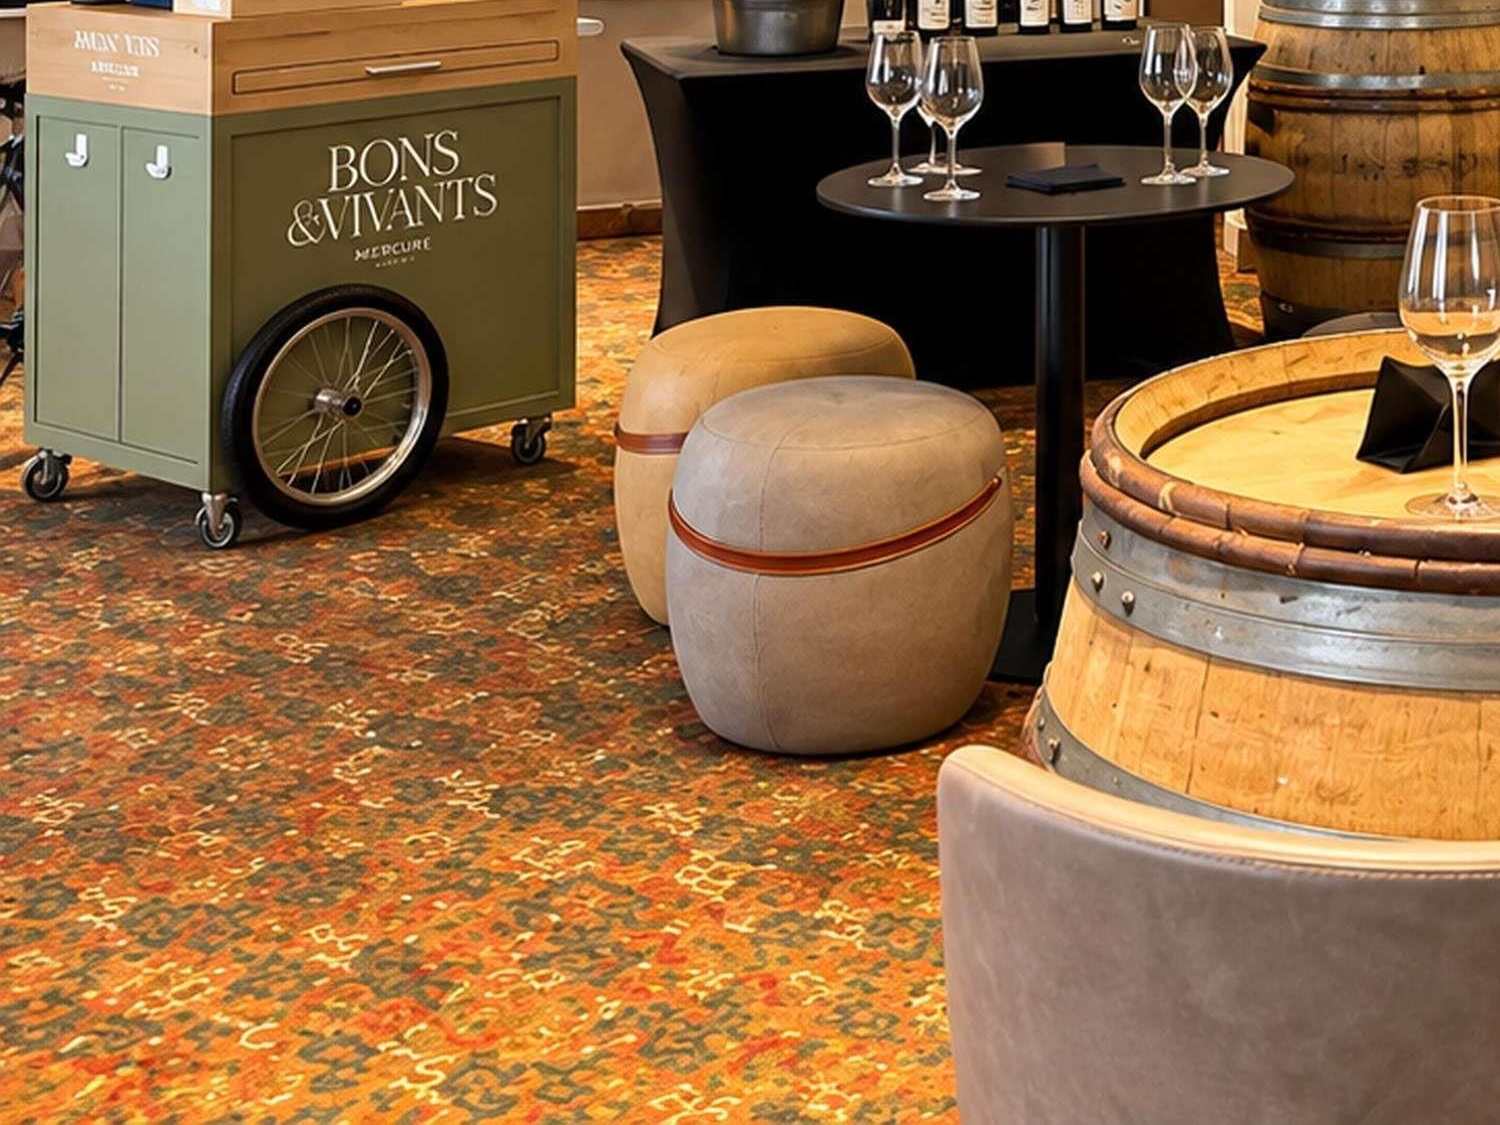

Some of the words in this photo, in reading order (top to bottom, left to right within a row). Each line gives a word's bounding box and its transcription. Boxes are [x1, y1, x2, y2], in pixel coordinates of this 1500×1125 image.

[328, 129, 460, 192] BONS
[287, 173, 499, 247] &VIVANTS
[354, 237, 432, 262] MERCURE
